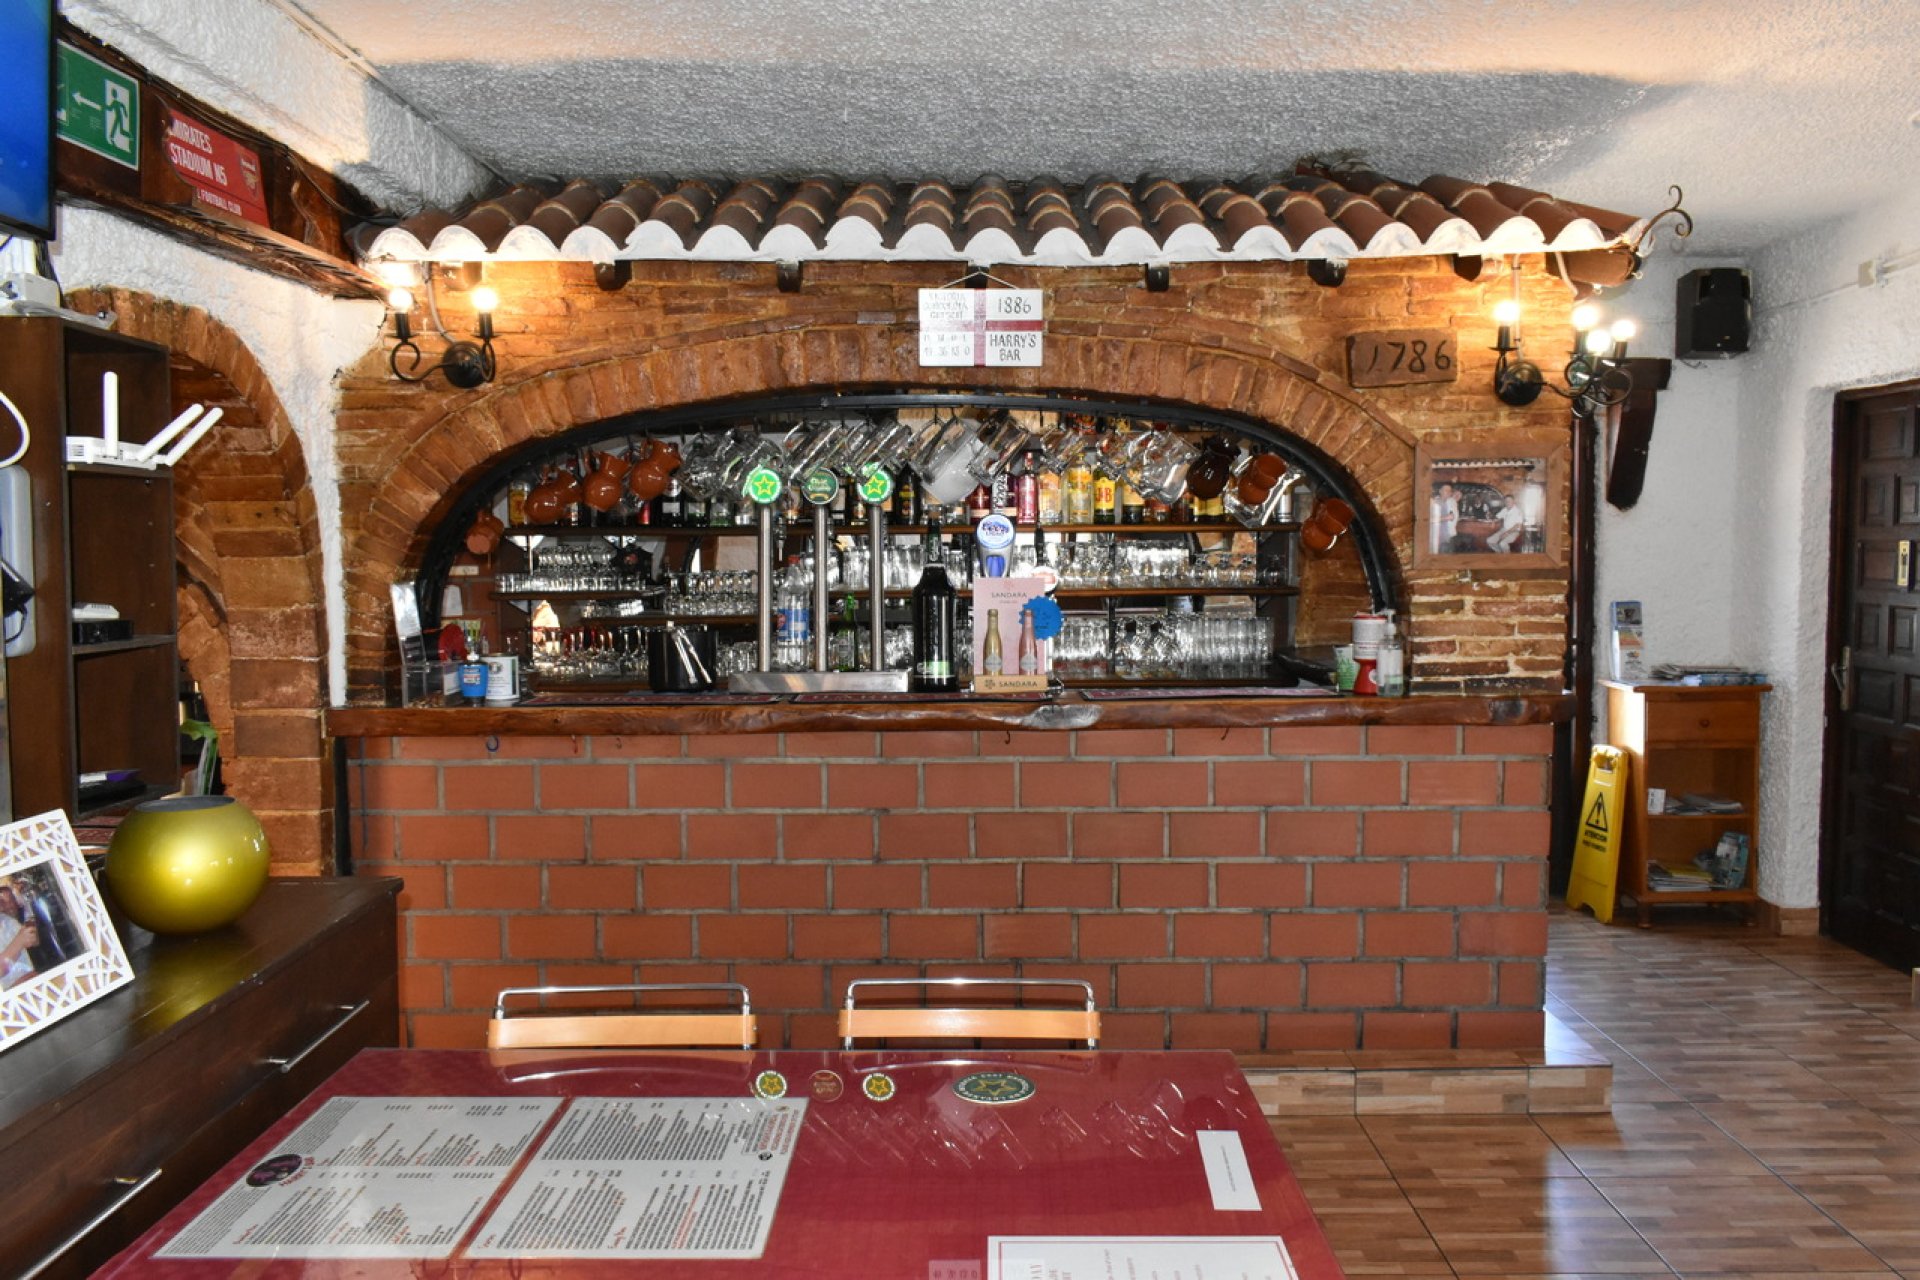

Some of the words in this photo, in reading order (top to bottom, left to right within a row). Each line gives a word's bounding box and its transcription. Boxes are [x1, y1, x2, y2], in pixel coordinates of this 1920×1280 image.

[170, 143, 214, 180] STADIUM
[998, 296, 1032, 314] 1886
[990, 334, 1037, 348] HARRY'S
[1000, 348, 1021, 362] BAR
[1366, 340, 1452, 374] 1786
[991, 591, 1028, 599] SANDARA
[999, 679, 1038, 688] SANDARA
